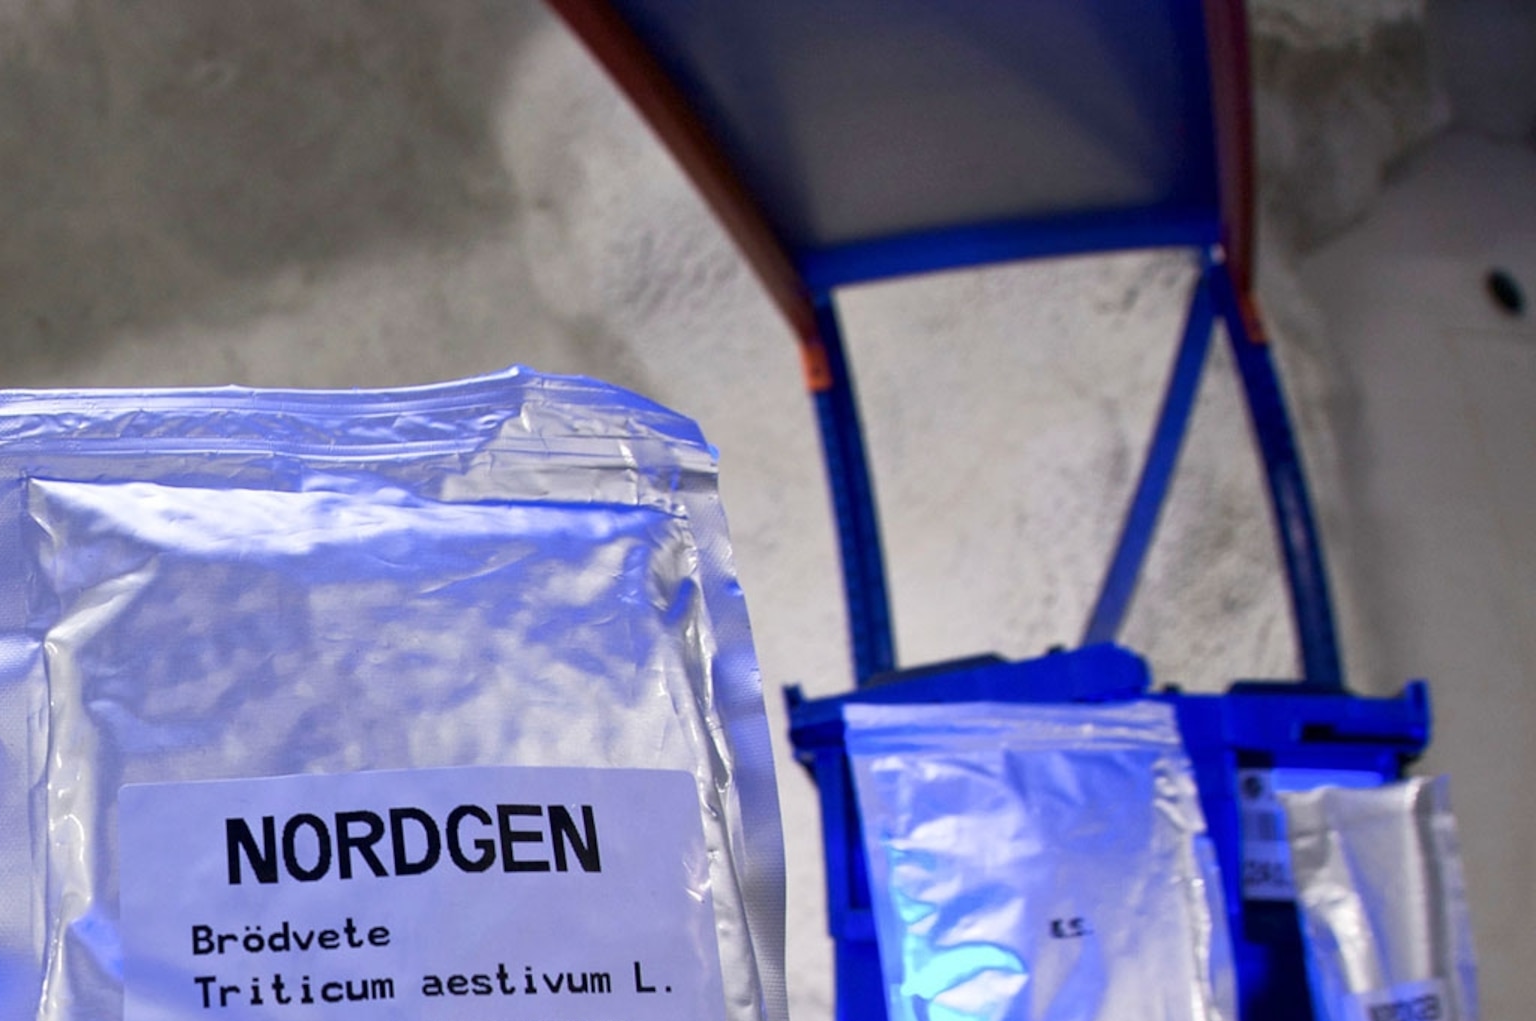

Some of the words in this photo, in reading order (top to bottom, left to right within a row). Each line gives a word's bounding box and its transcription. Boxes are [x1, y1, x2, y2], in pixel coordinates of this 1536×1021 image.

[226, 804, 601, 885] NORDGEN
[192, 918, 390, 955] Brödvete
[195, 974, 395, 1008] Triticum
[422, 963, 611, 996] aestivum
[634, 962, 672, 993] L.
